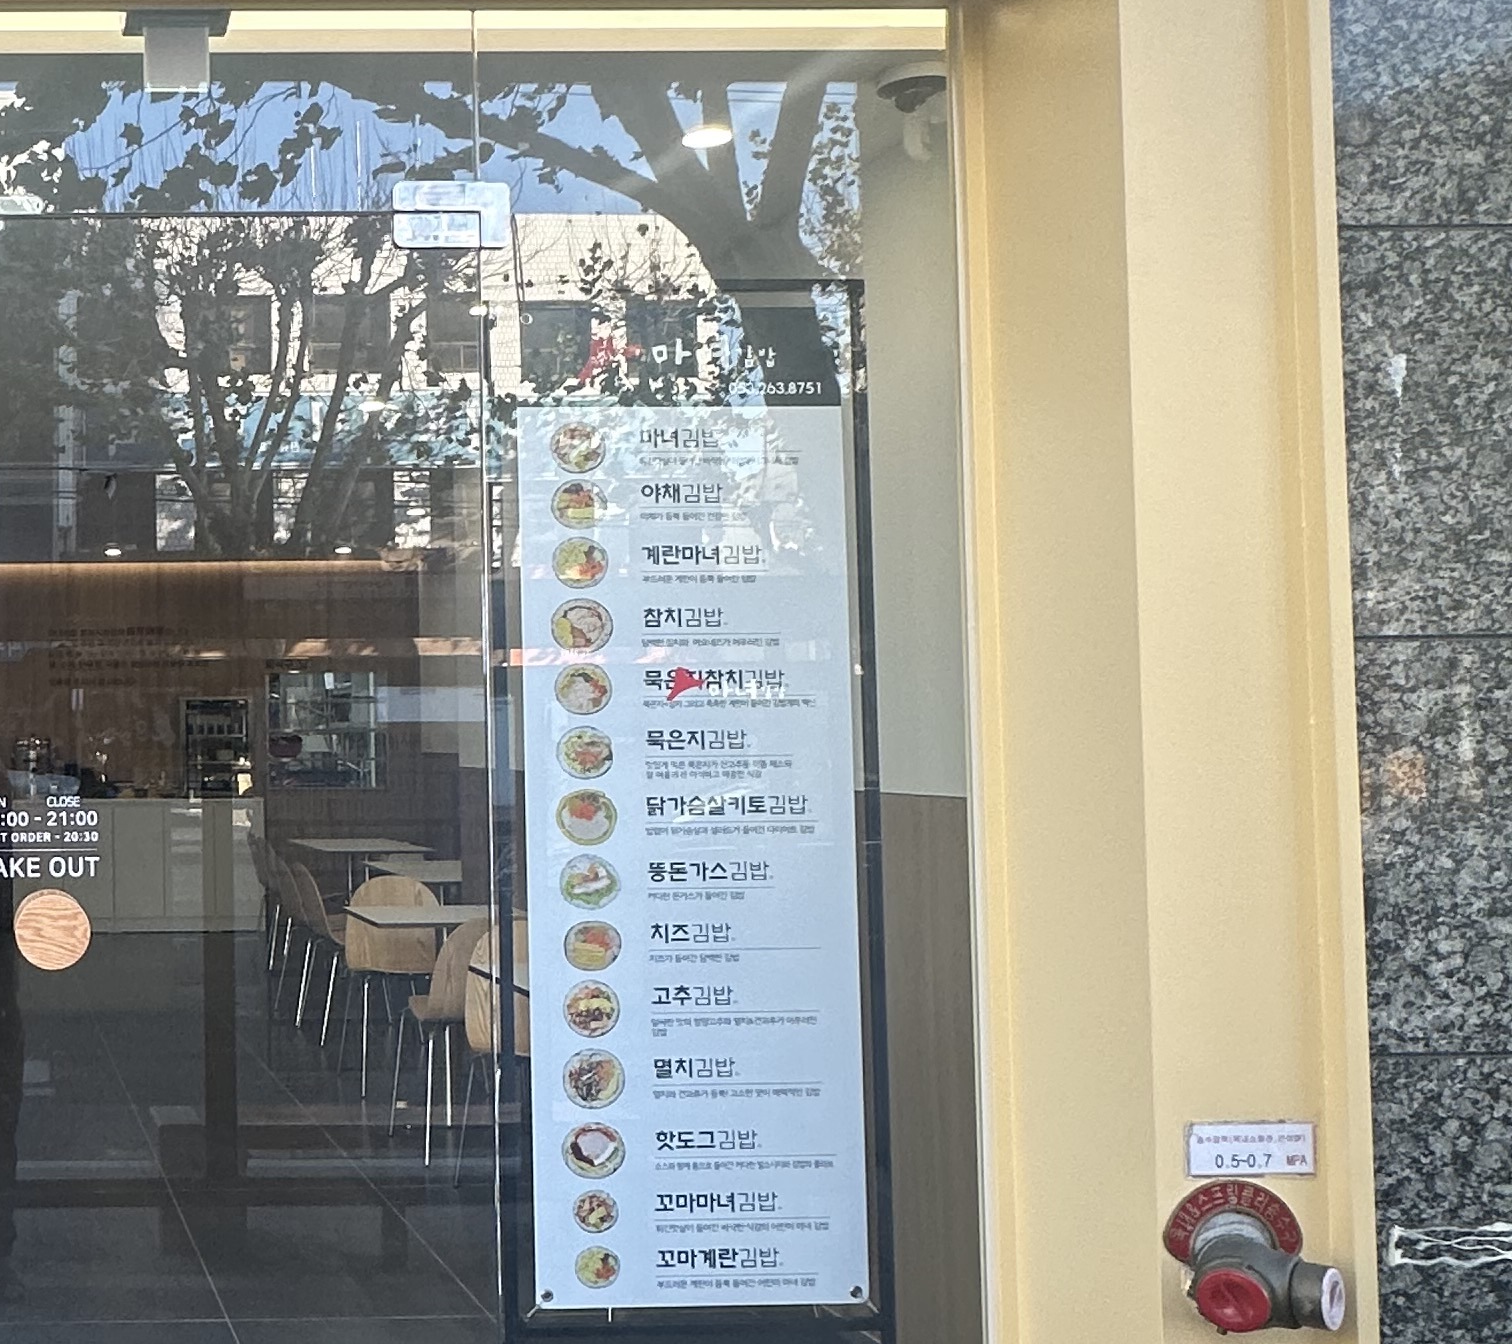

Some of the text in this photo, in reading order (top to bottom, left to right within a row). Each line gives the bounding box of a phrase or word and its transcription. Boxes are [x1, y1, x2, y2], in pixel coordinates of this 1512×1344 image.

[640, 428, 719, 449] 마녀김밥
[641, 483, 723, 504] 야채김밥
[642, 545, 762, 565] 계란마녀김밥
[643, 607, 724, 628] 참치김밥
[645, 729, 747, 750] 묵은지김밥
[46, 796, 80, 808] CLOSE
[646, 795, 808, 816] 닭가슴살키토김밥
[46, 811, 98, 827] 21:00
[11, 832, 51, 843] ORDER
[63, 831, 98, 843] 20:30
[49, 856, 99, 878] OUT
[651, 923, 731, 943] 치즈김밥
[651, 985, 733, 1006] 고추김밥
[654, 1057, 735, 1079] 멸치김밥
[655, 1130, 757, 1151] 핫도그김밥
[655, 1191, 777, 1213] 꼬마마녀김밥
[656, 1247, 779, 1268] 꼬마계란김밥
